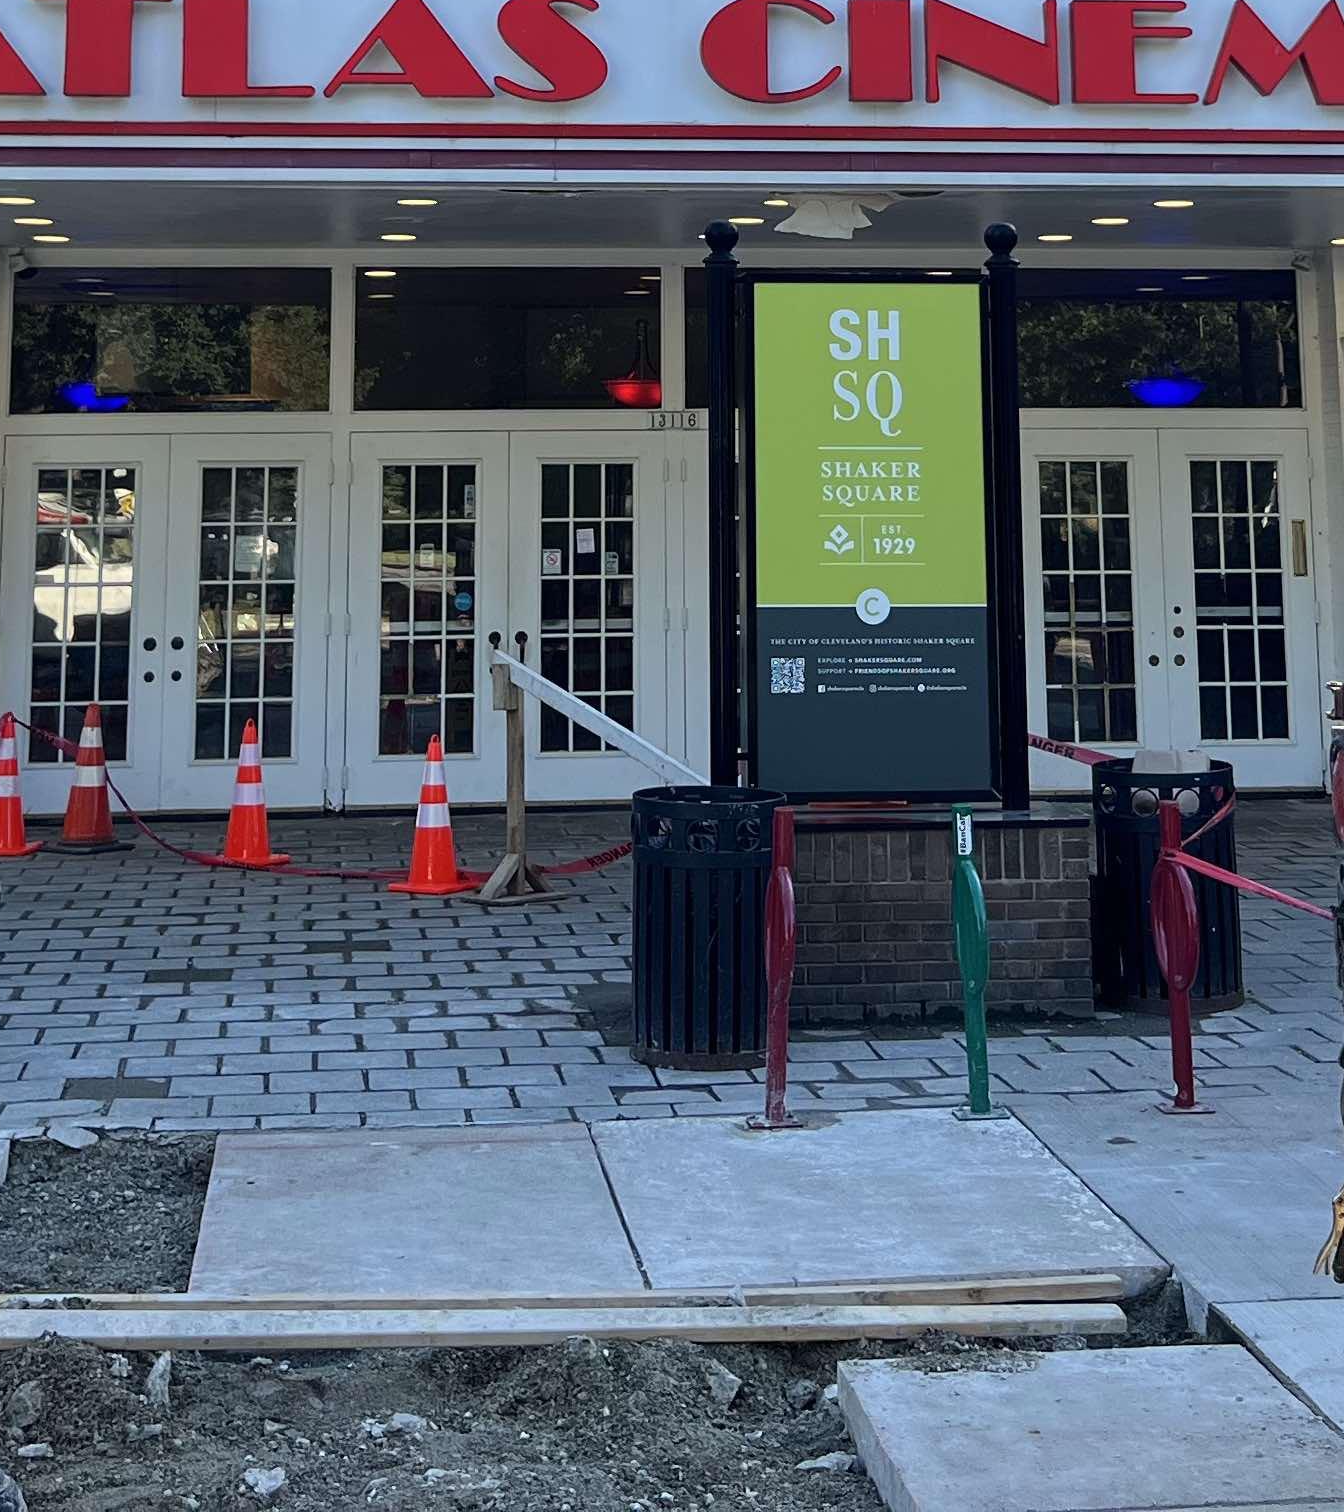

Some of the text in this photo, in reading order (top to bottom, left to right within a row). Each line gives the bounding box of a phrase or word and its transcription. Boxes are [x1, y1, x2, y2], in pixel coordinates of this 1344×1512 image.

[828, 308, 901, 361] SH
[832, 369, 904, 437] SQ
[650, 413, 697, 428] 13116
[820, 461, 922, 479] SHAKER
[822, 484, 922, 508] SQUARE
[873, 537, 916, 555] 1929
[945, 638, 976, 647] SQUARE
